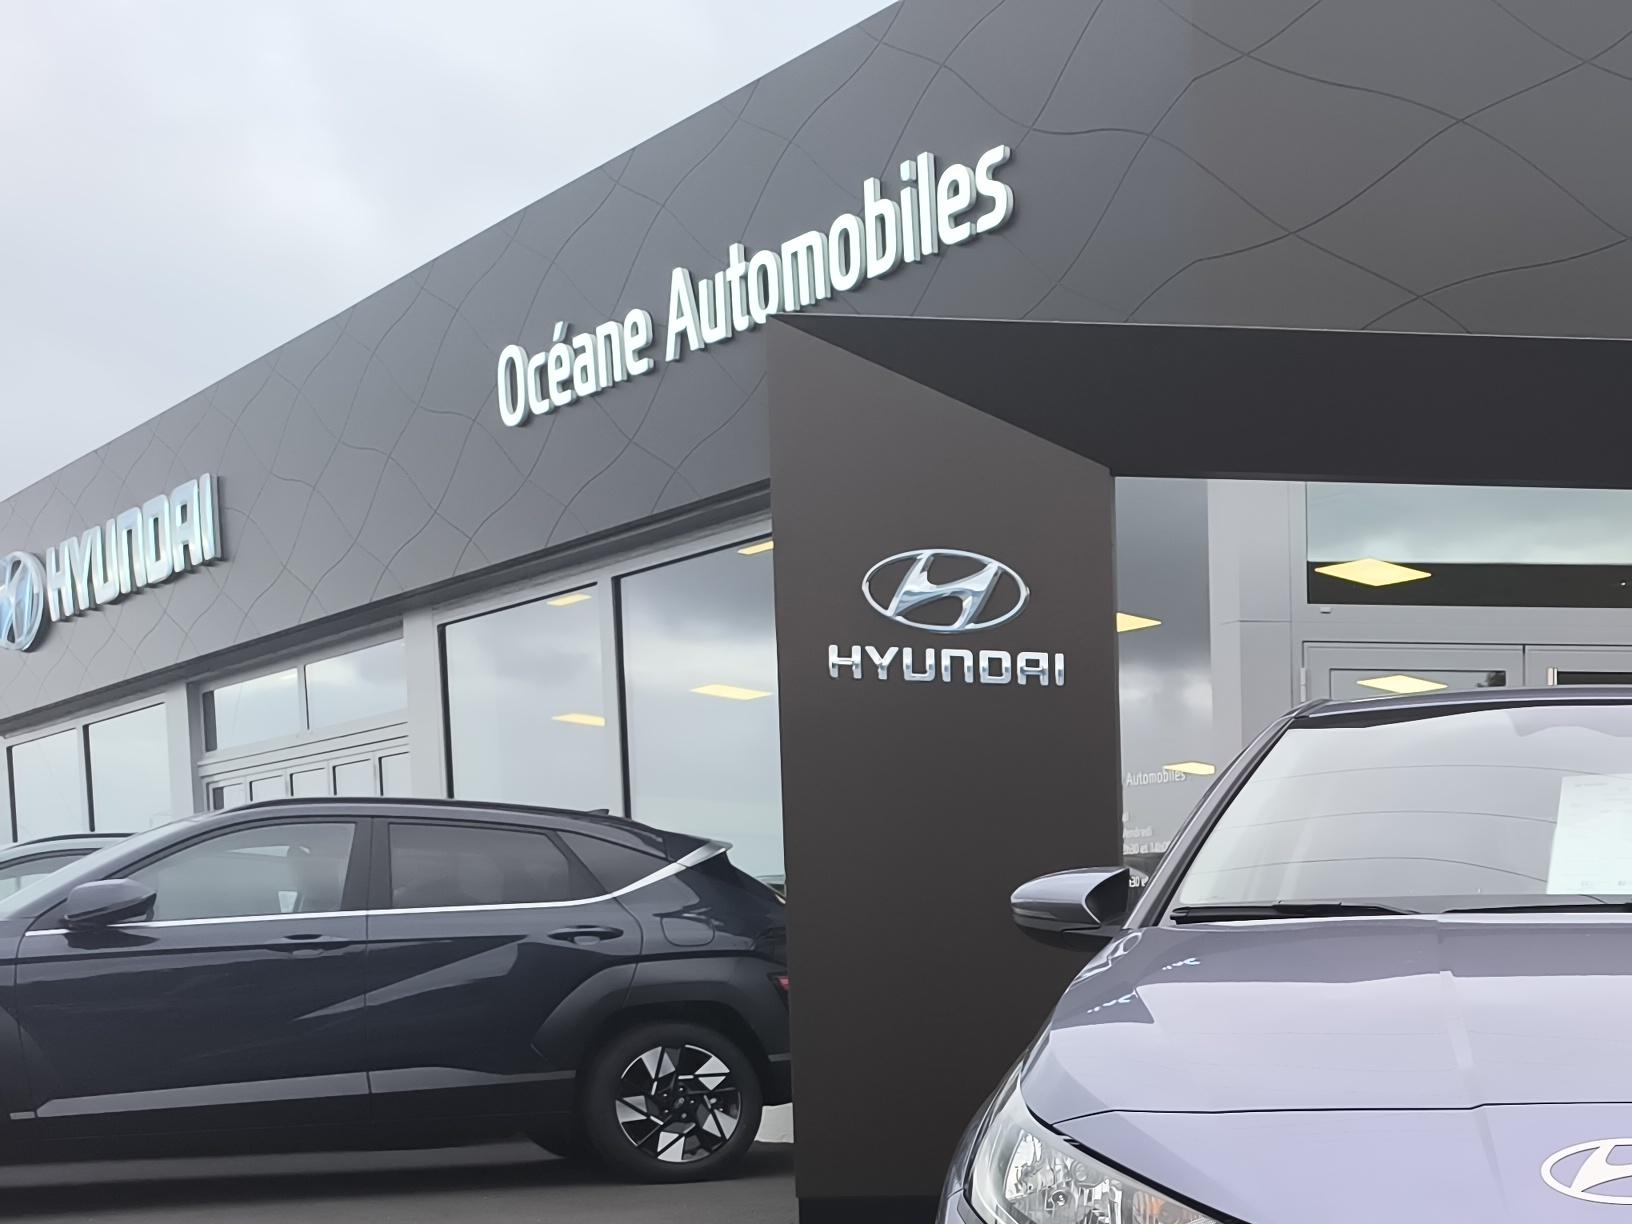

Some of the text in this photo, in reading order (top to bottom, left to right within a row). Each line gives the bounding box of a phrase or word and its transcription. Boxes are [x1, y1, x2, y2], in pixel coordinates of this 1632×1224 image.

[497, 145, 1013, 427] Océane Automobiles
[46, 472, 221, 622] HYUNDAI
[828, 644, 1065, 686] HYUNDAI
